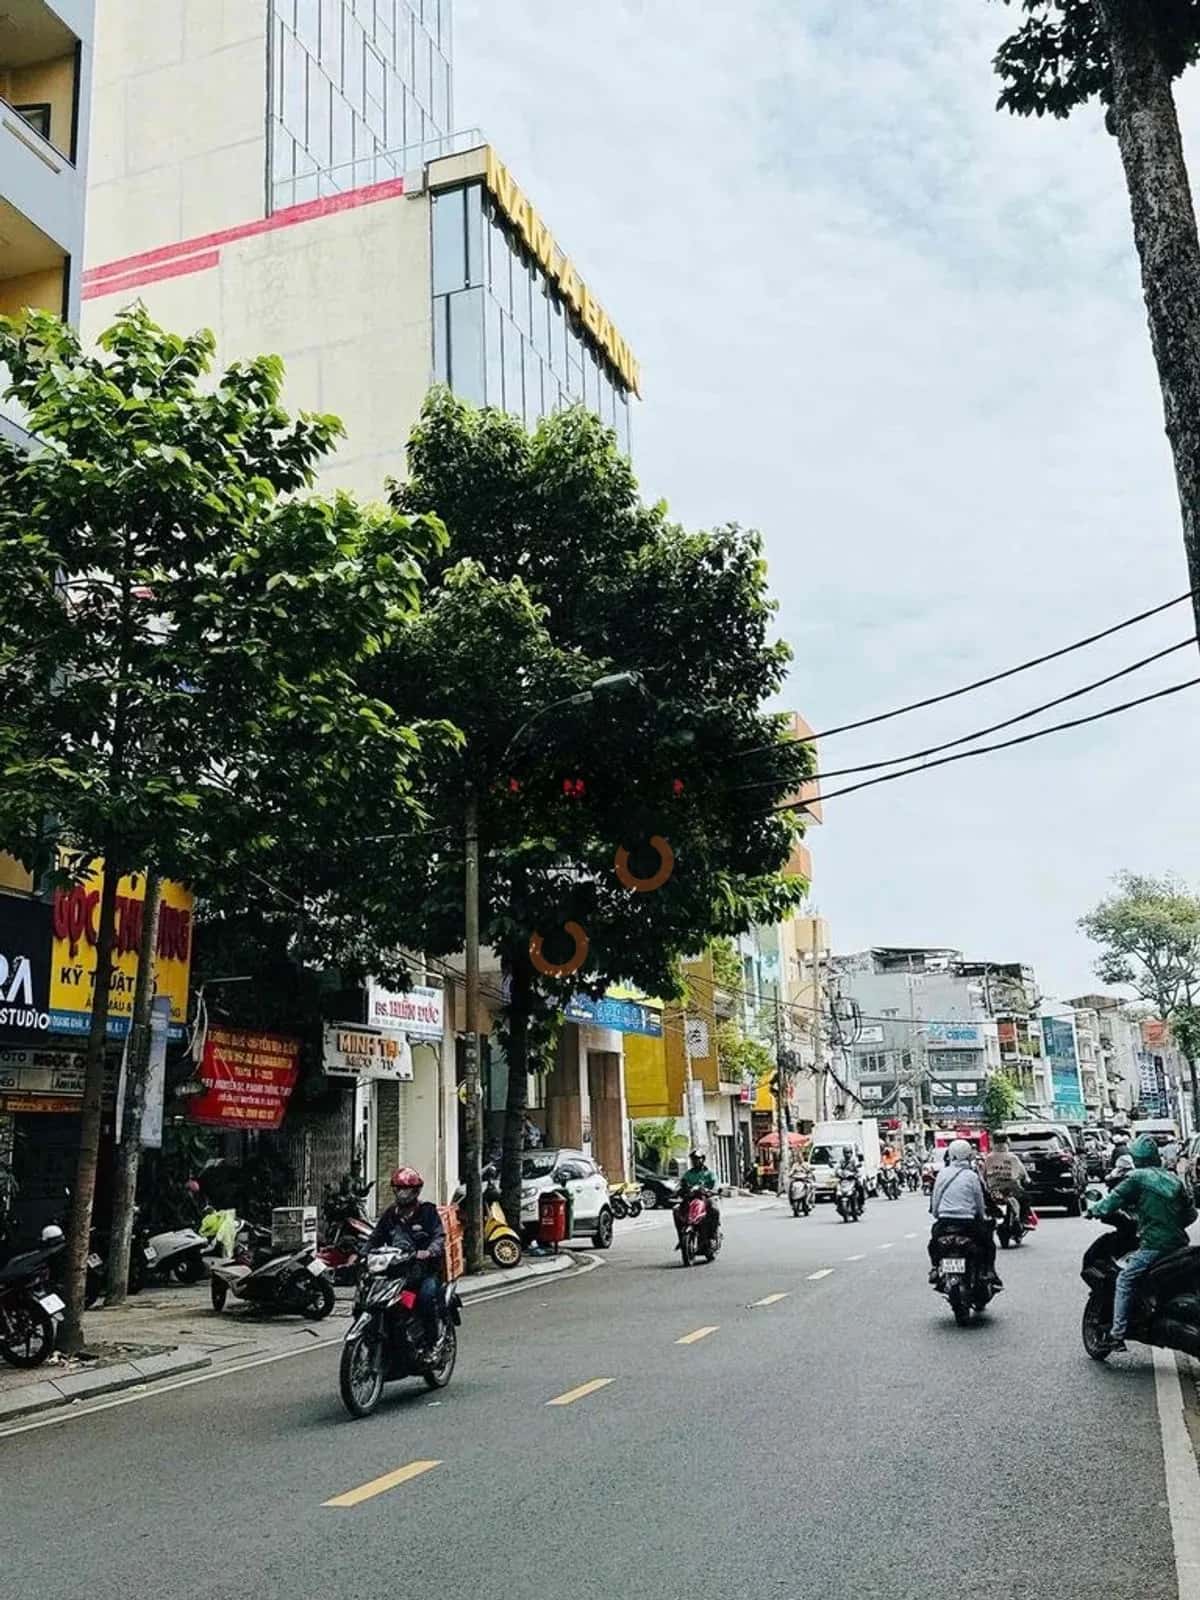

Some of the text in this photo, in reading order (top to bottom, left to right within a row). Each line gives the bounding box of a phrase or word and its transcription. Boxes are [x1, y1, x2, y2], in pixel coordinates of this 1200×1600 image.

[485, 145, 557, 276] NAM
[578, 281, 641, 393] BANK
[61, 964, 83, 986] KỸ
